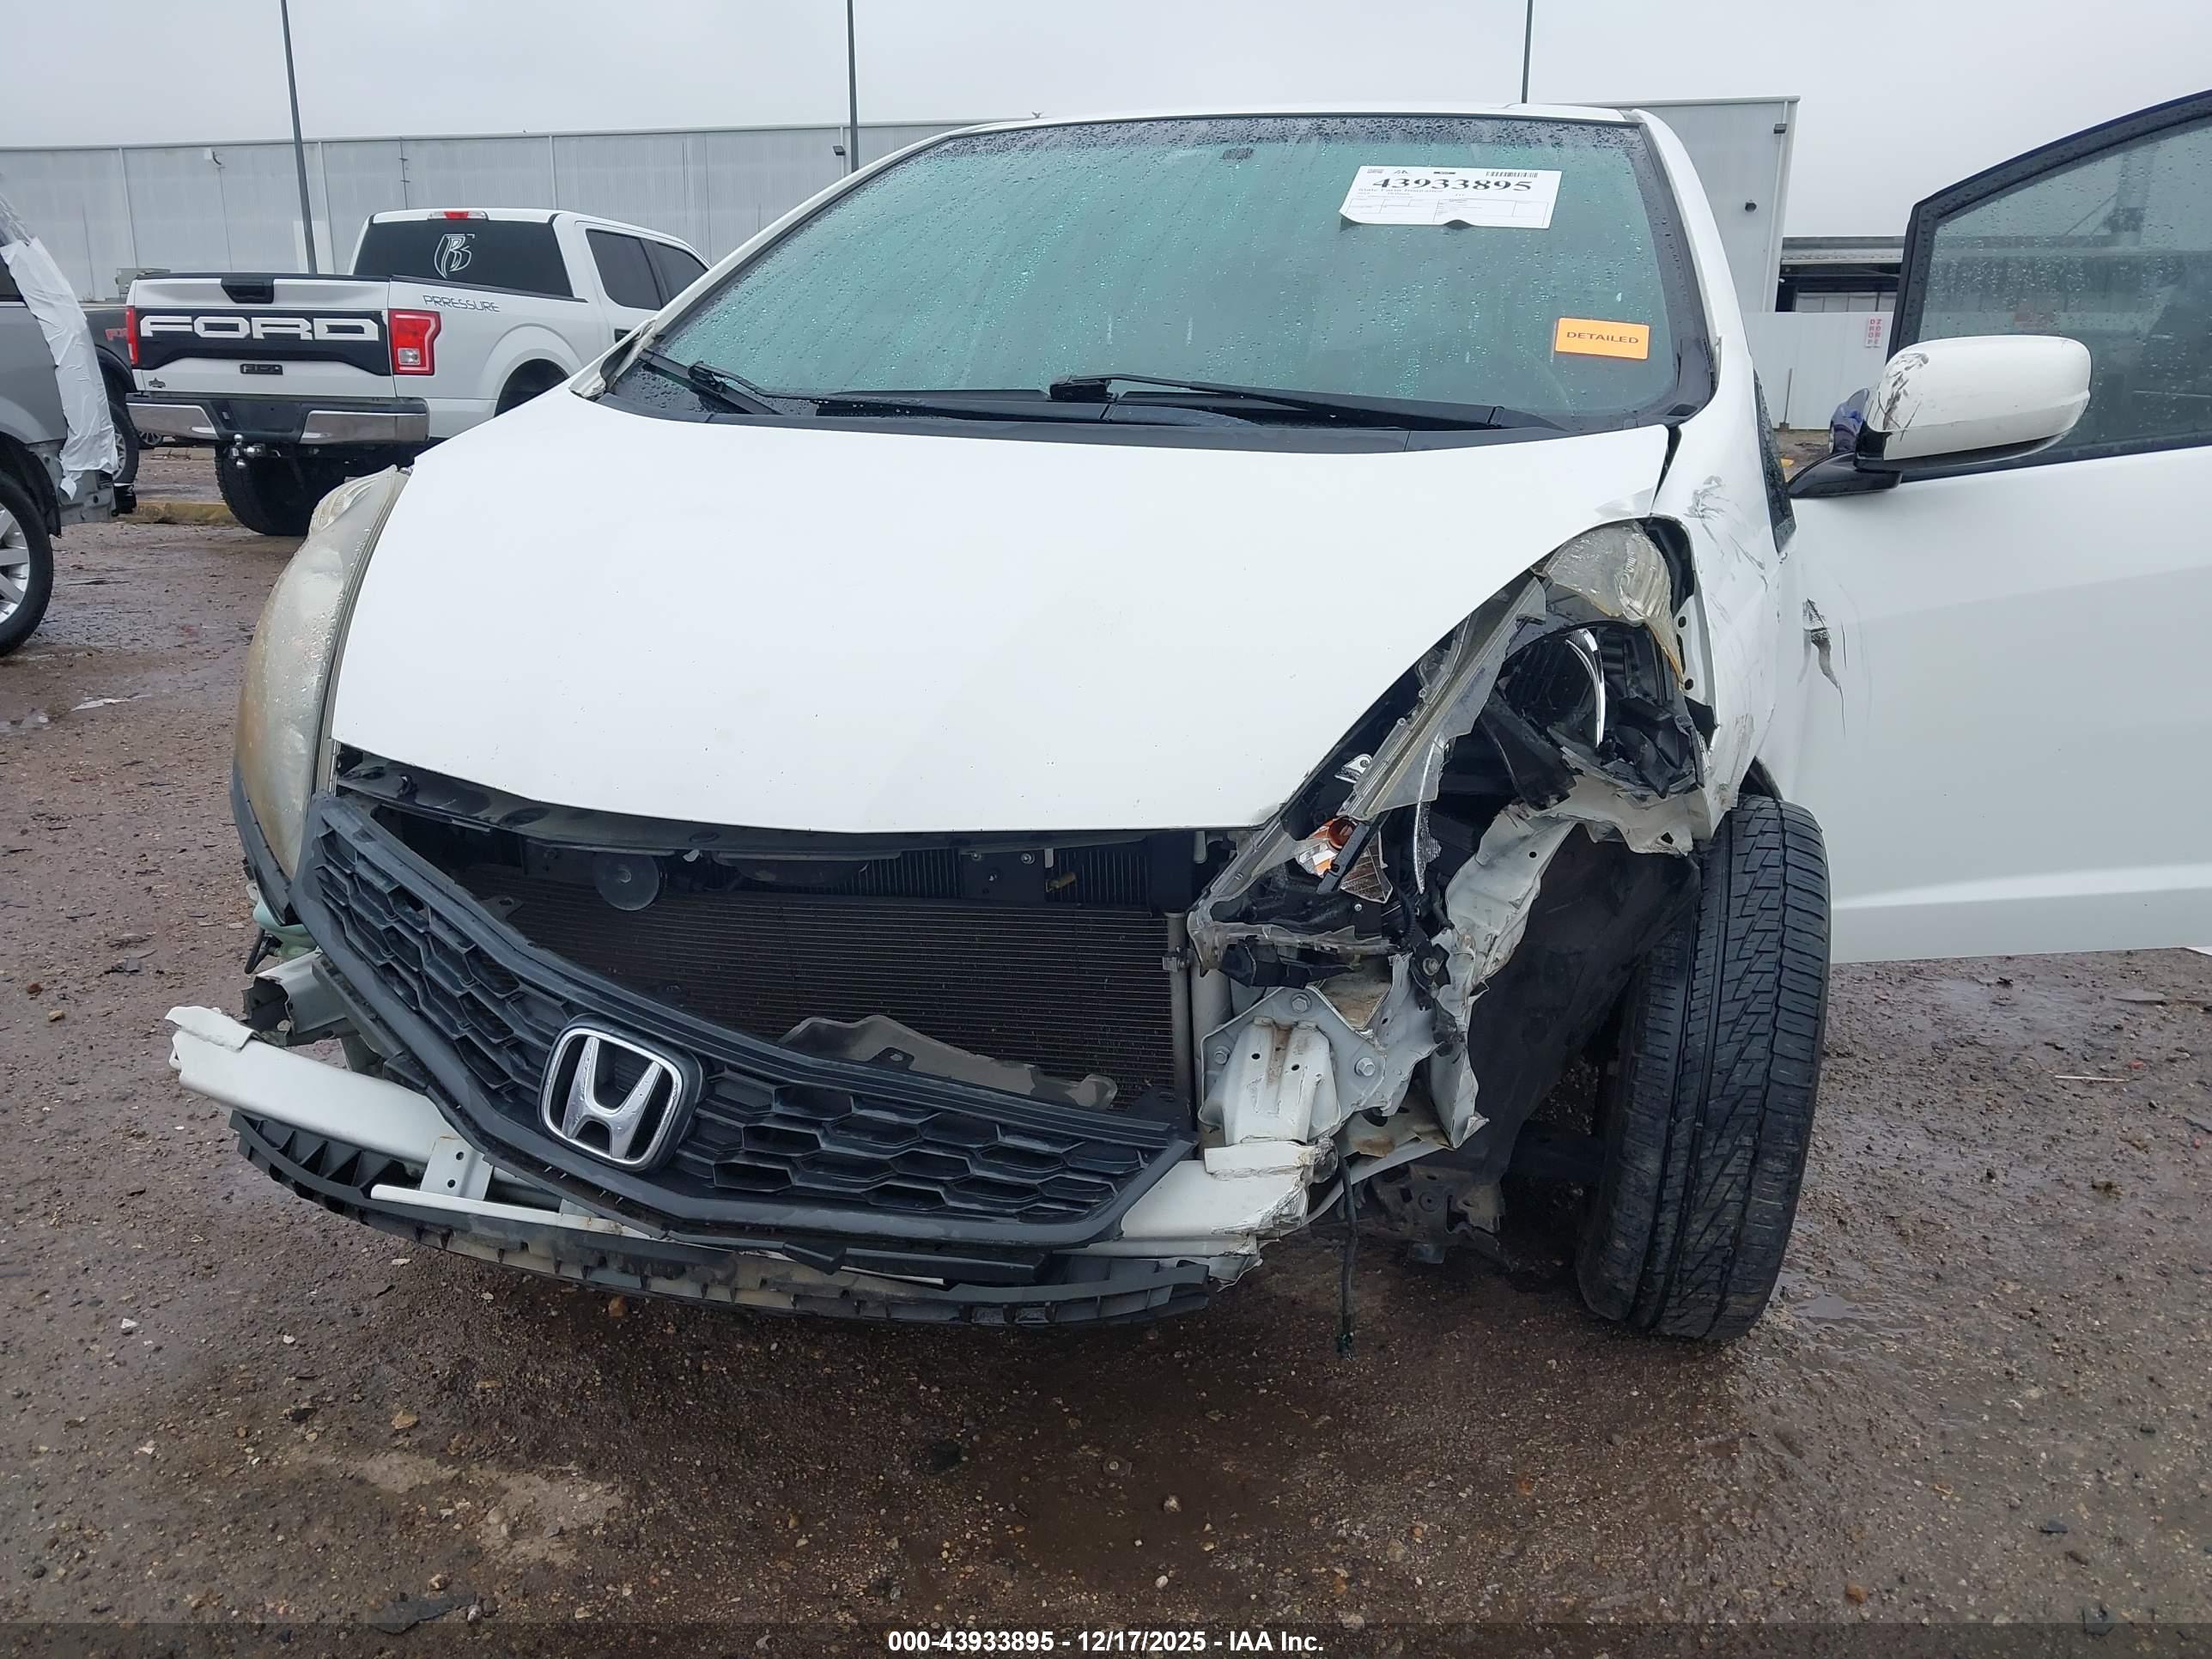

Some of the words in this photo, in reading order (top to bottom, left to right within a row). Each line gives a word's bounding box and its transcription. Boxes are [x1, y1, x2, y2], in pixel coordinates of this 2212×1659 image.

[1372, 178, 1532, 191] 43933895
[422, 295, 501, 313] PRRESSURE
[140, 315, 380, 342] FORD
[1566, 331, 1639, 343] DETAILED
